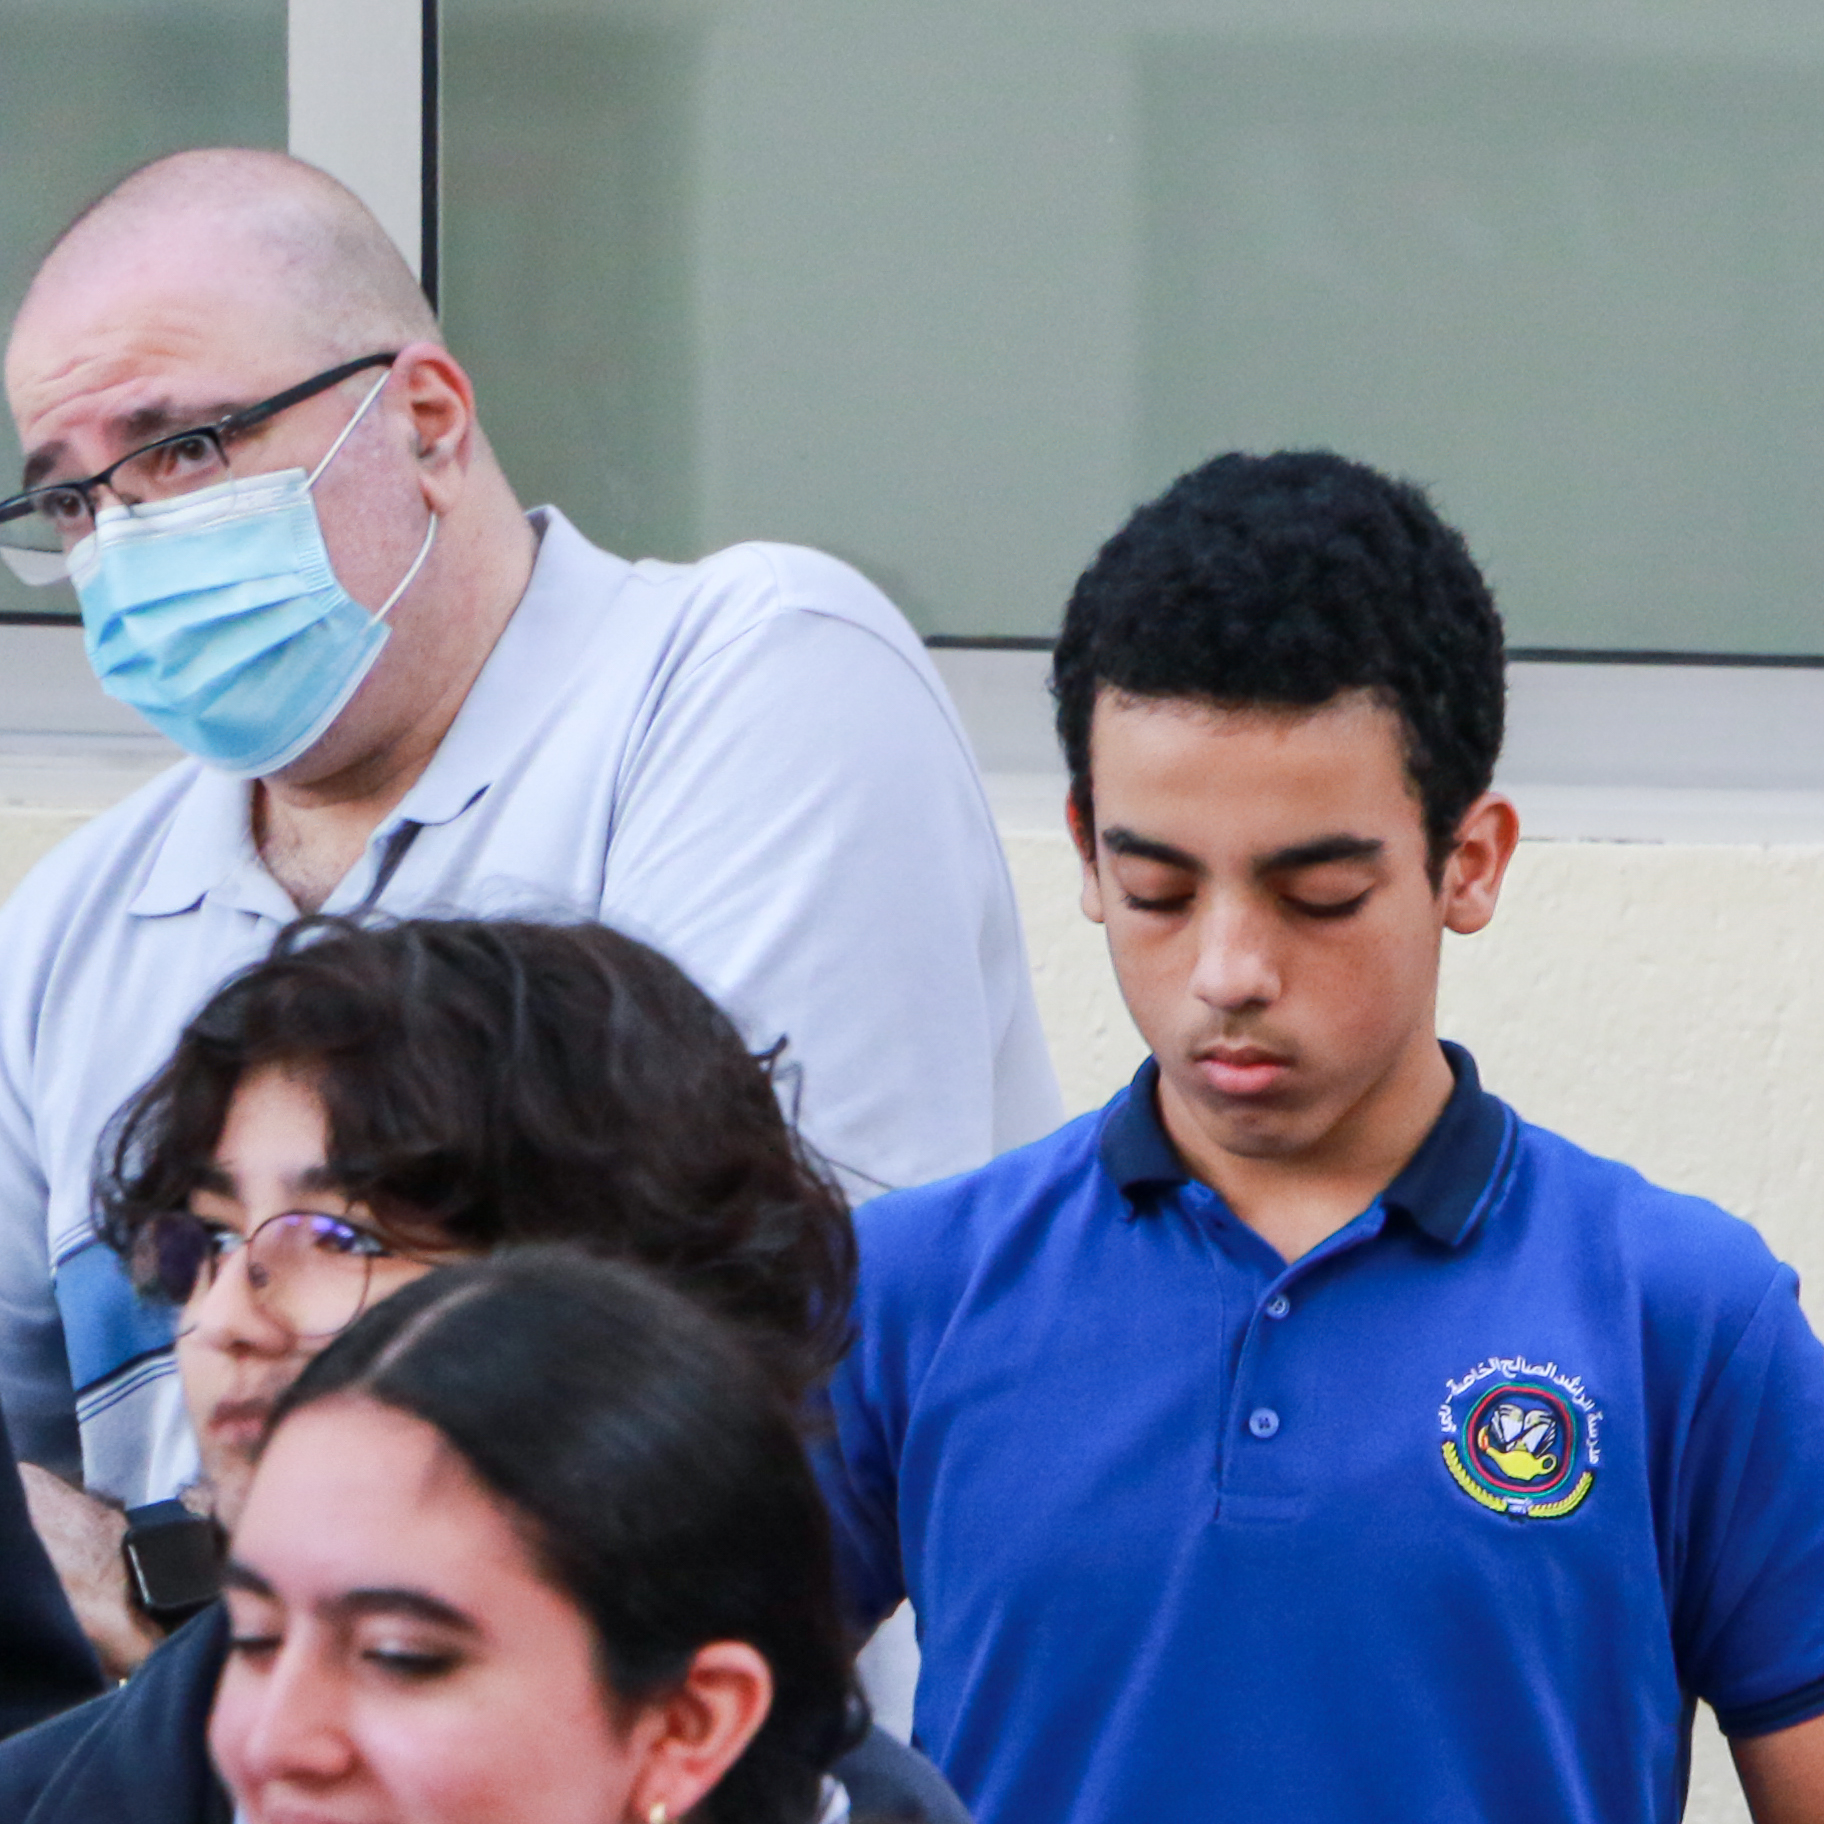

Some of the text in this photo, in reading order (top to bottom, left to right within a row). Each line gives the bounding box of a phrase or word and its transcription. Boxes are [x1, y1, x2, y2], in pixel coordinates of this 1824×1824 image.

[1446, 1356, 1501, 1396] الخاصة
[1500, 1355, 1557, 1379] الصالح
[1585, 1410, 1604, 1465] مدرسة
